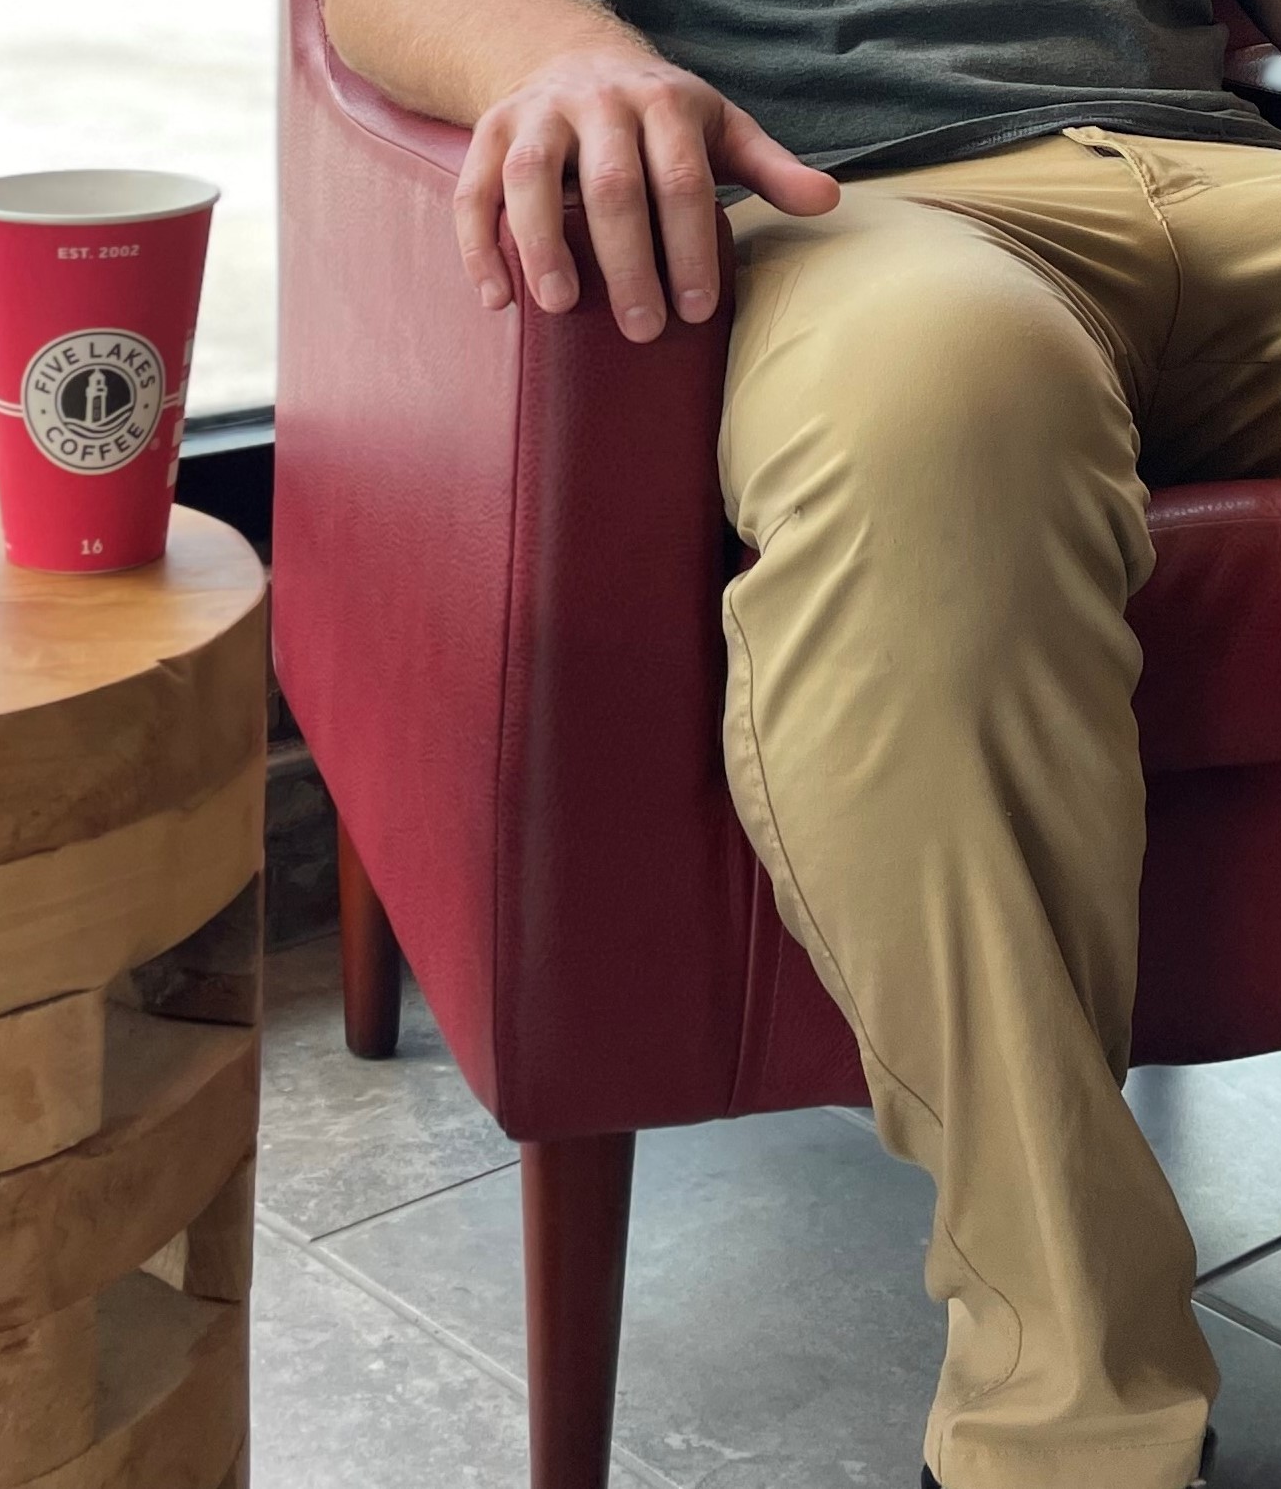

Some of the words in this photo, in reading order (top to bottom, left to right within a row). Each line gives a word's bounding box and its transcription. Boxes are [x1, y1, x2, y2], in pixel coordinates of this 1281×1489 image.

[57, 247, 93, 260] EST.
[99, 244, 141, 259] 2002
[34, 347, 79, 395] FIVE
[89, 342, 155, 390] LAKES
[46, 422, 145, 462] COFFEE
[81, 538, 103, 555] 16
